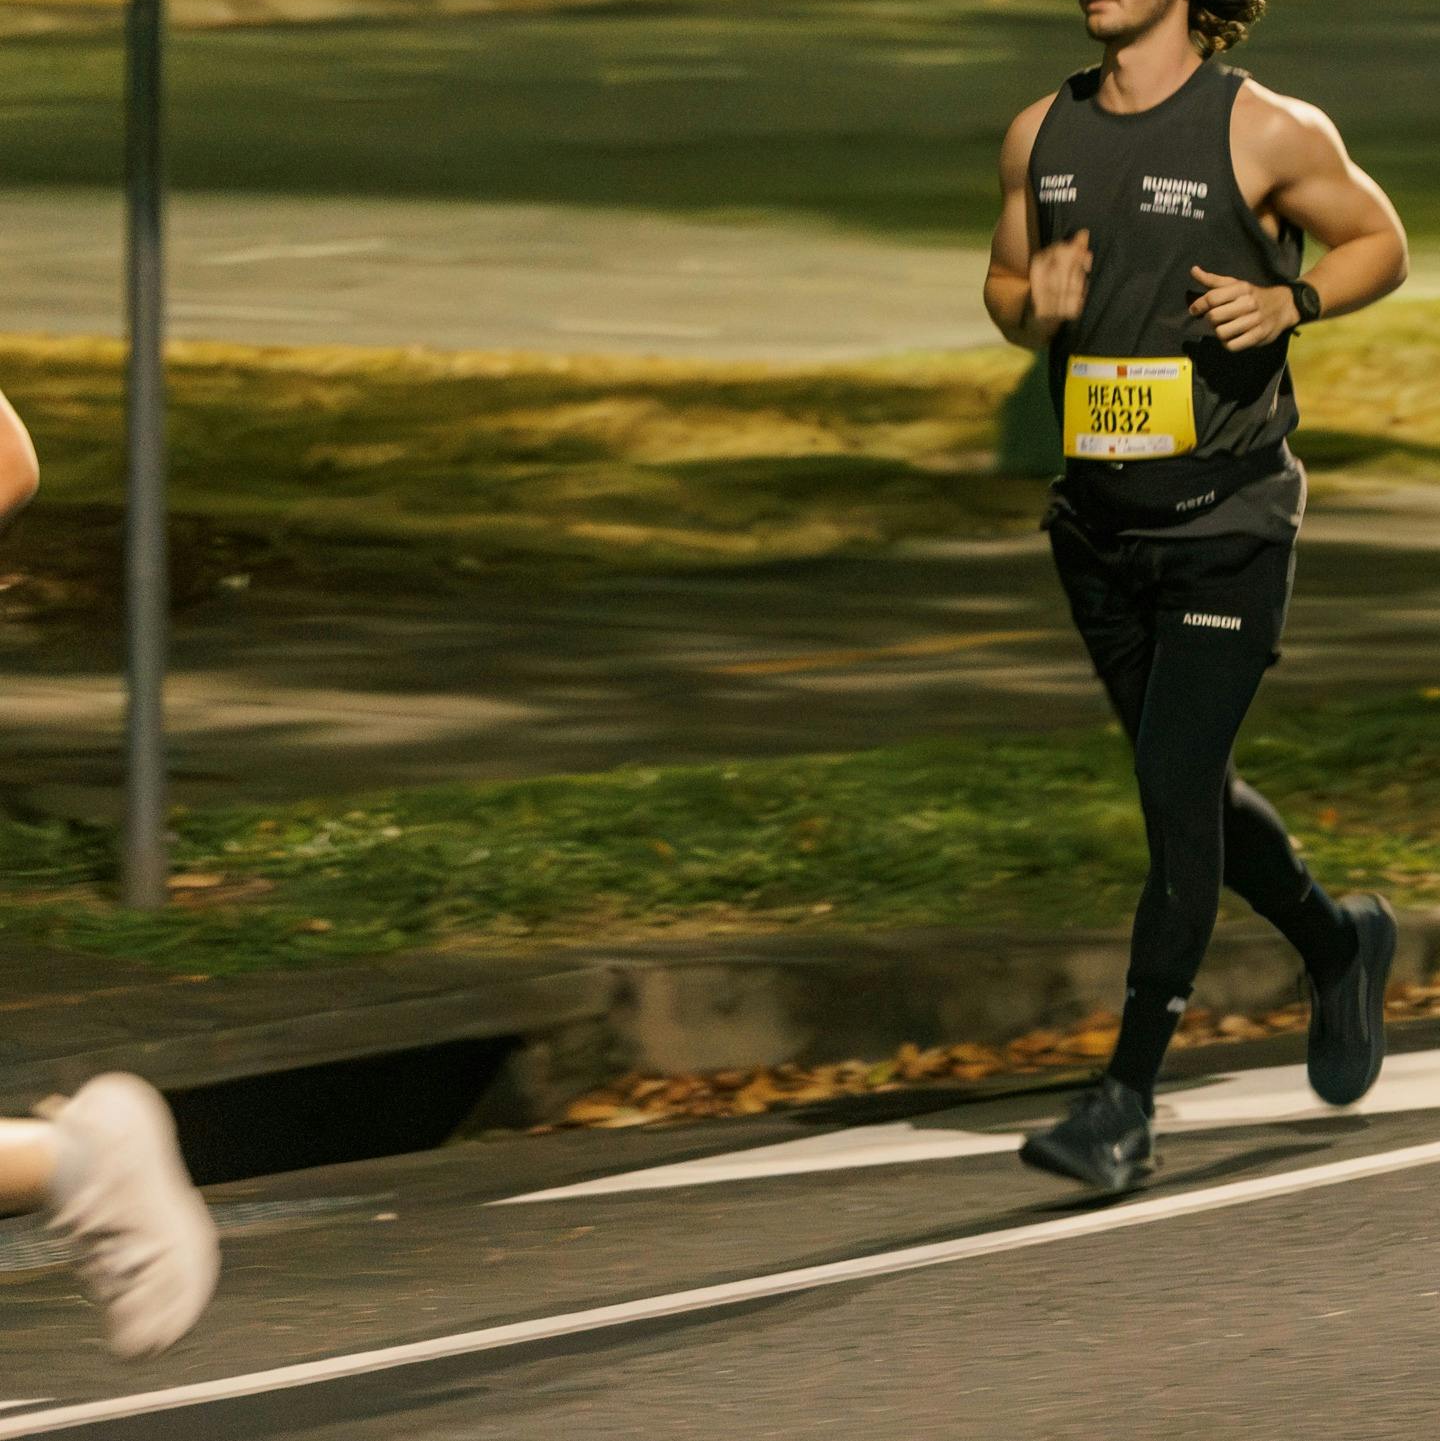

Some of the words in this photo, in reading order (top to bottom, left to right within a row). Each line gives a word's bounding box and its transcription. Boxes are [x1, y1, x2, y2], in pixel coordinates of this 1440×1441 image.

[1142, 175, 1208, 199] RUNNING
[1088, 385, 1152, 407] HEATH
[1090, 408, 1151, 434] 3032
